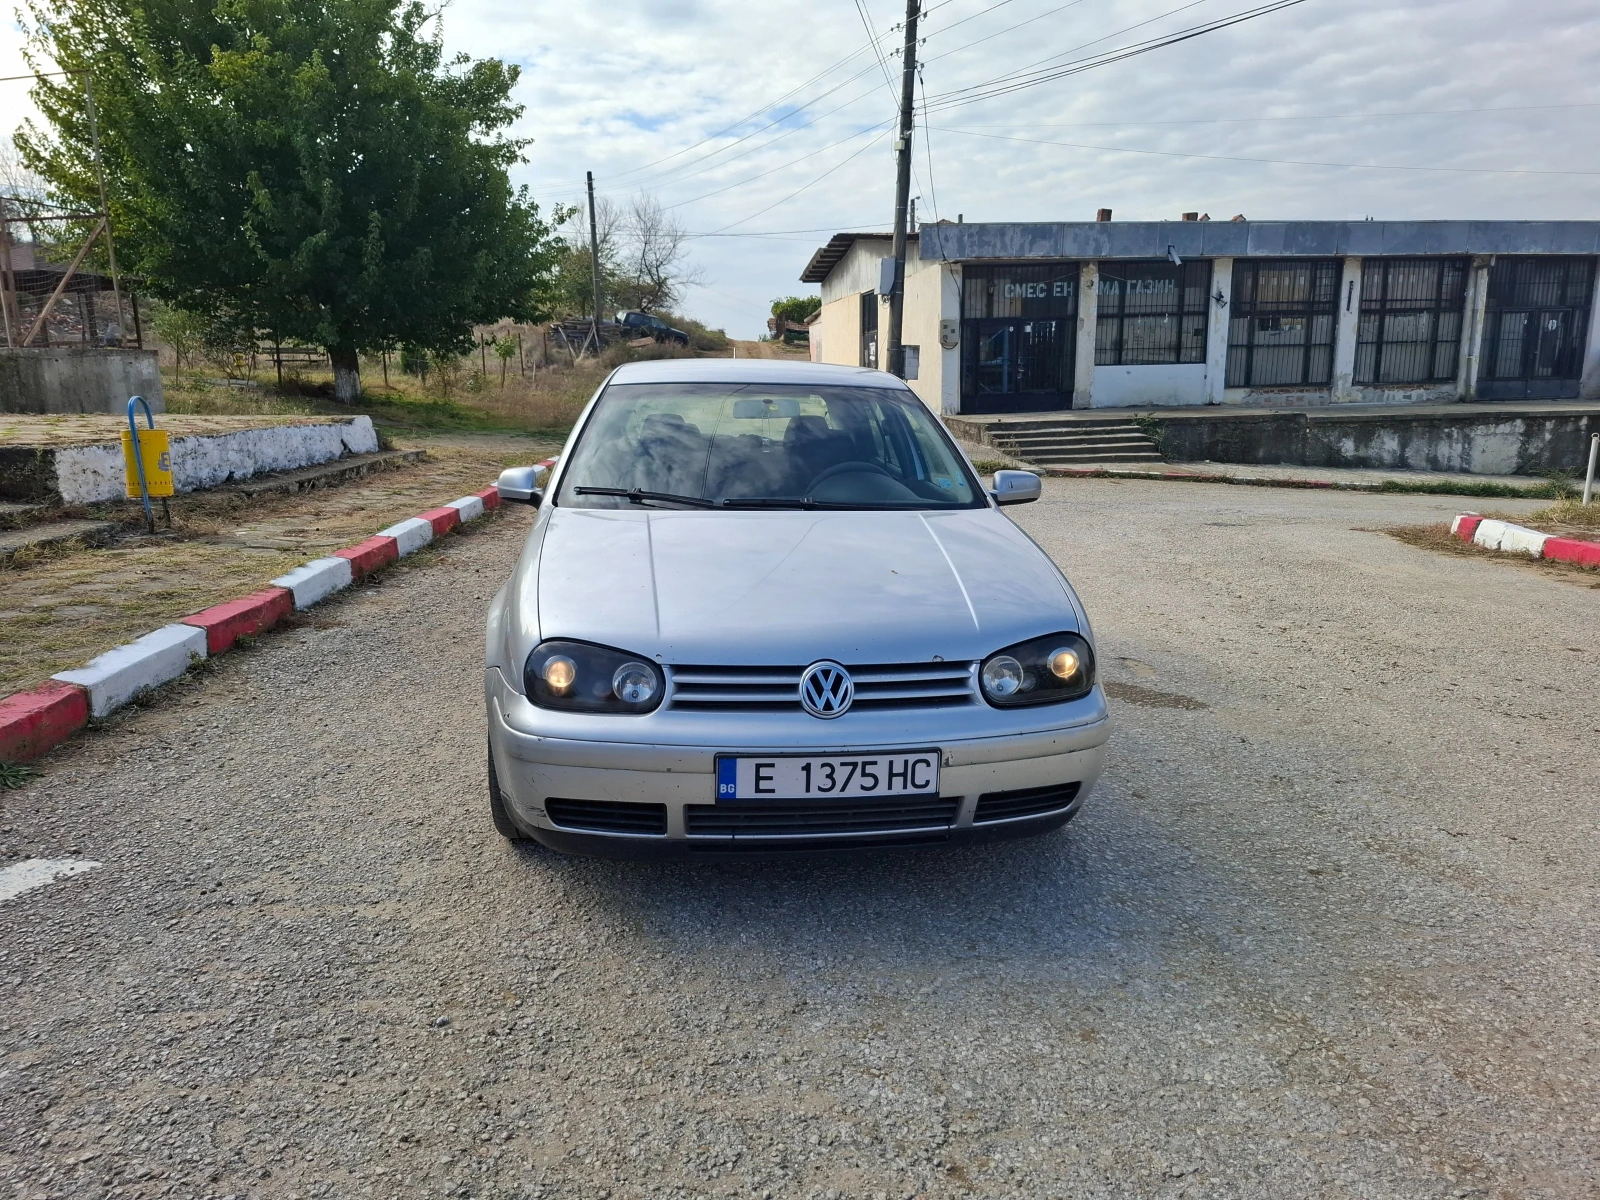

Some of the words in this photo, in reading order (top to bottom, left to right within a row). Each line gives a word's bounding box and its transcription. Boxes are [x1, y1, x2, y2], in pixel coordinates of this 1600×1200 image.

[803, 666, 851, 714] VW
[720, 783, 735, 794] BG
[754, 762, 776, 794] E
